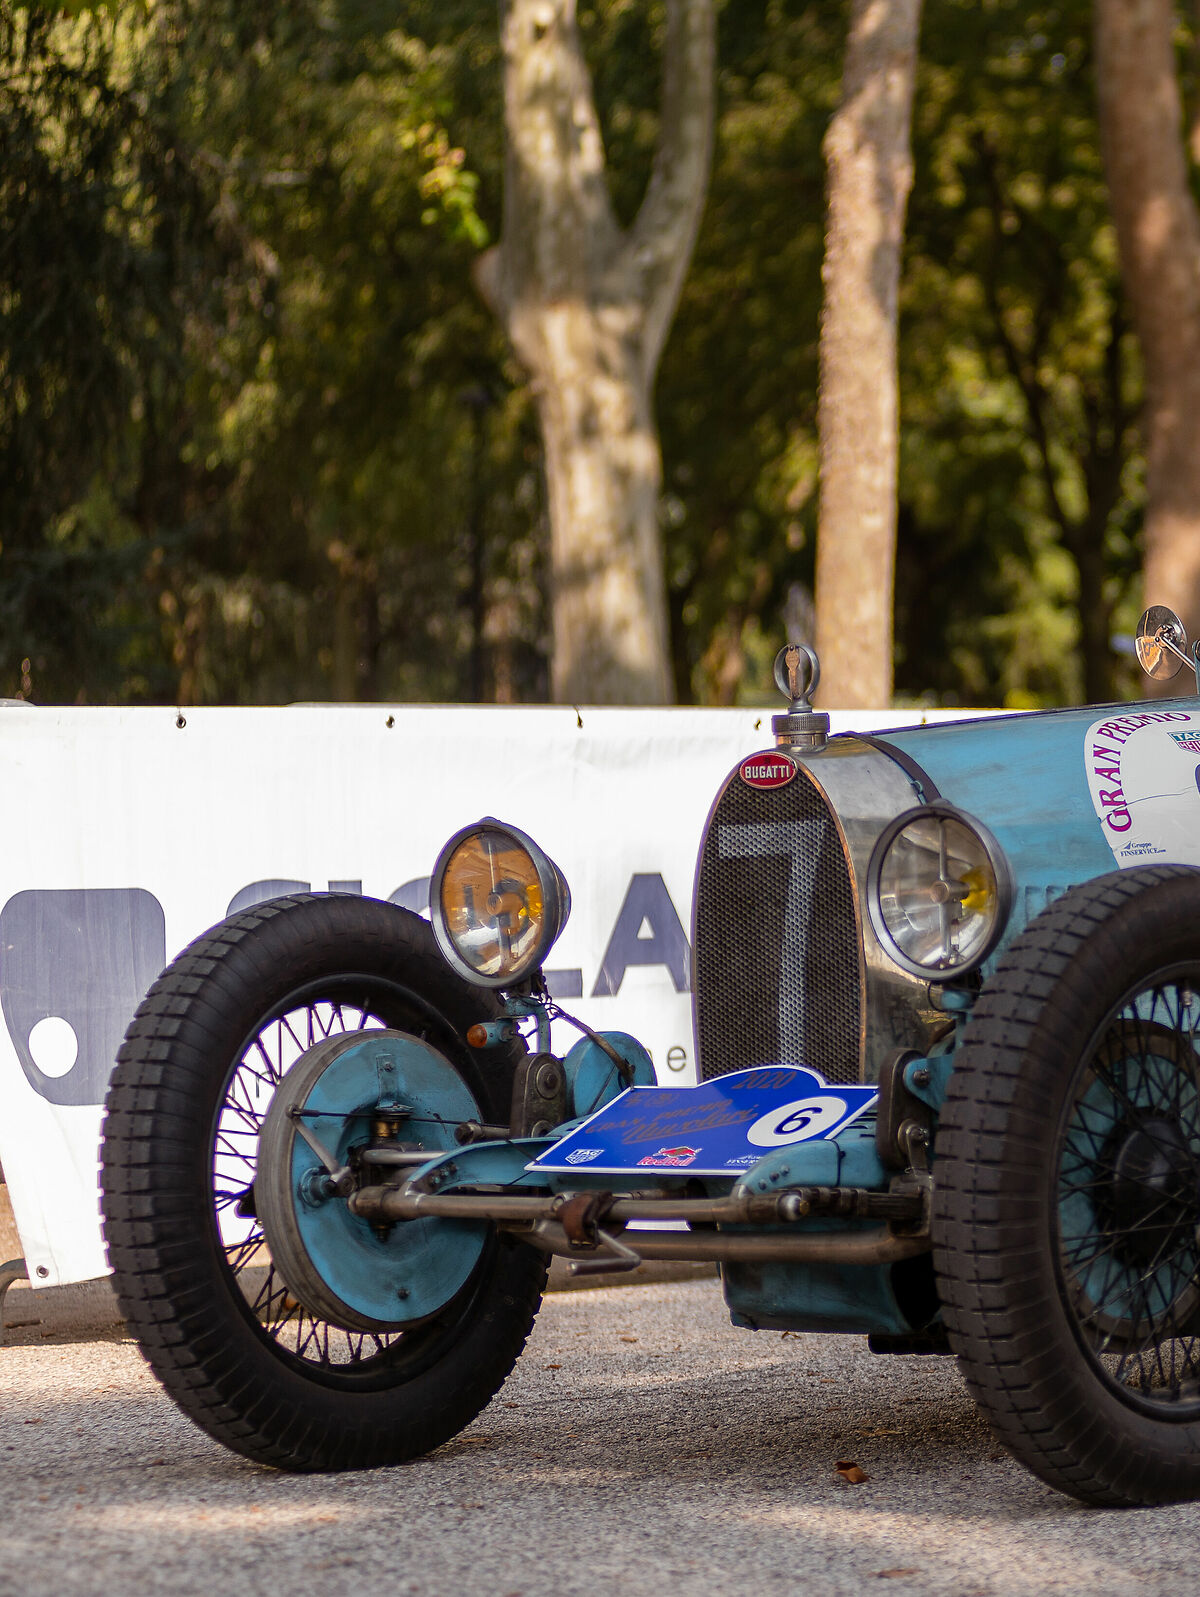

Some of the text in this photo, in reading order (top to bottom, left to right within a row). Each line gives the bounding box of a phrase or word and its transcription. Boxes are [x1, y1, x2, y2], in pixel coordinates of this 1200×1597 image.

[1097, 713, 1191, 744] PREMIO
[744, 765, 790, 779] BUGATTI
[1093, 744, 1132, 832] GRAN
[732, 1071, 797, 1089] 2020
[774, 1107, 823, 1135] 6
